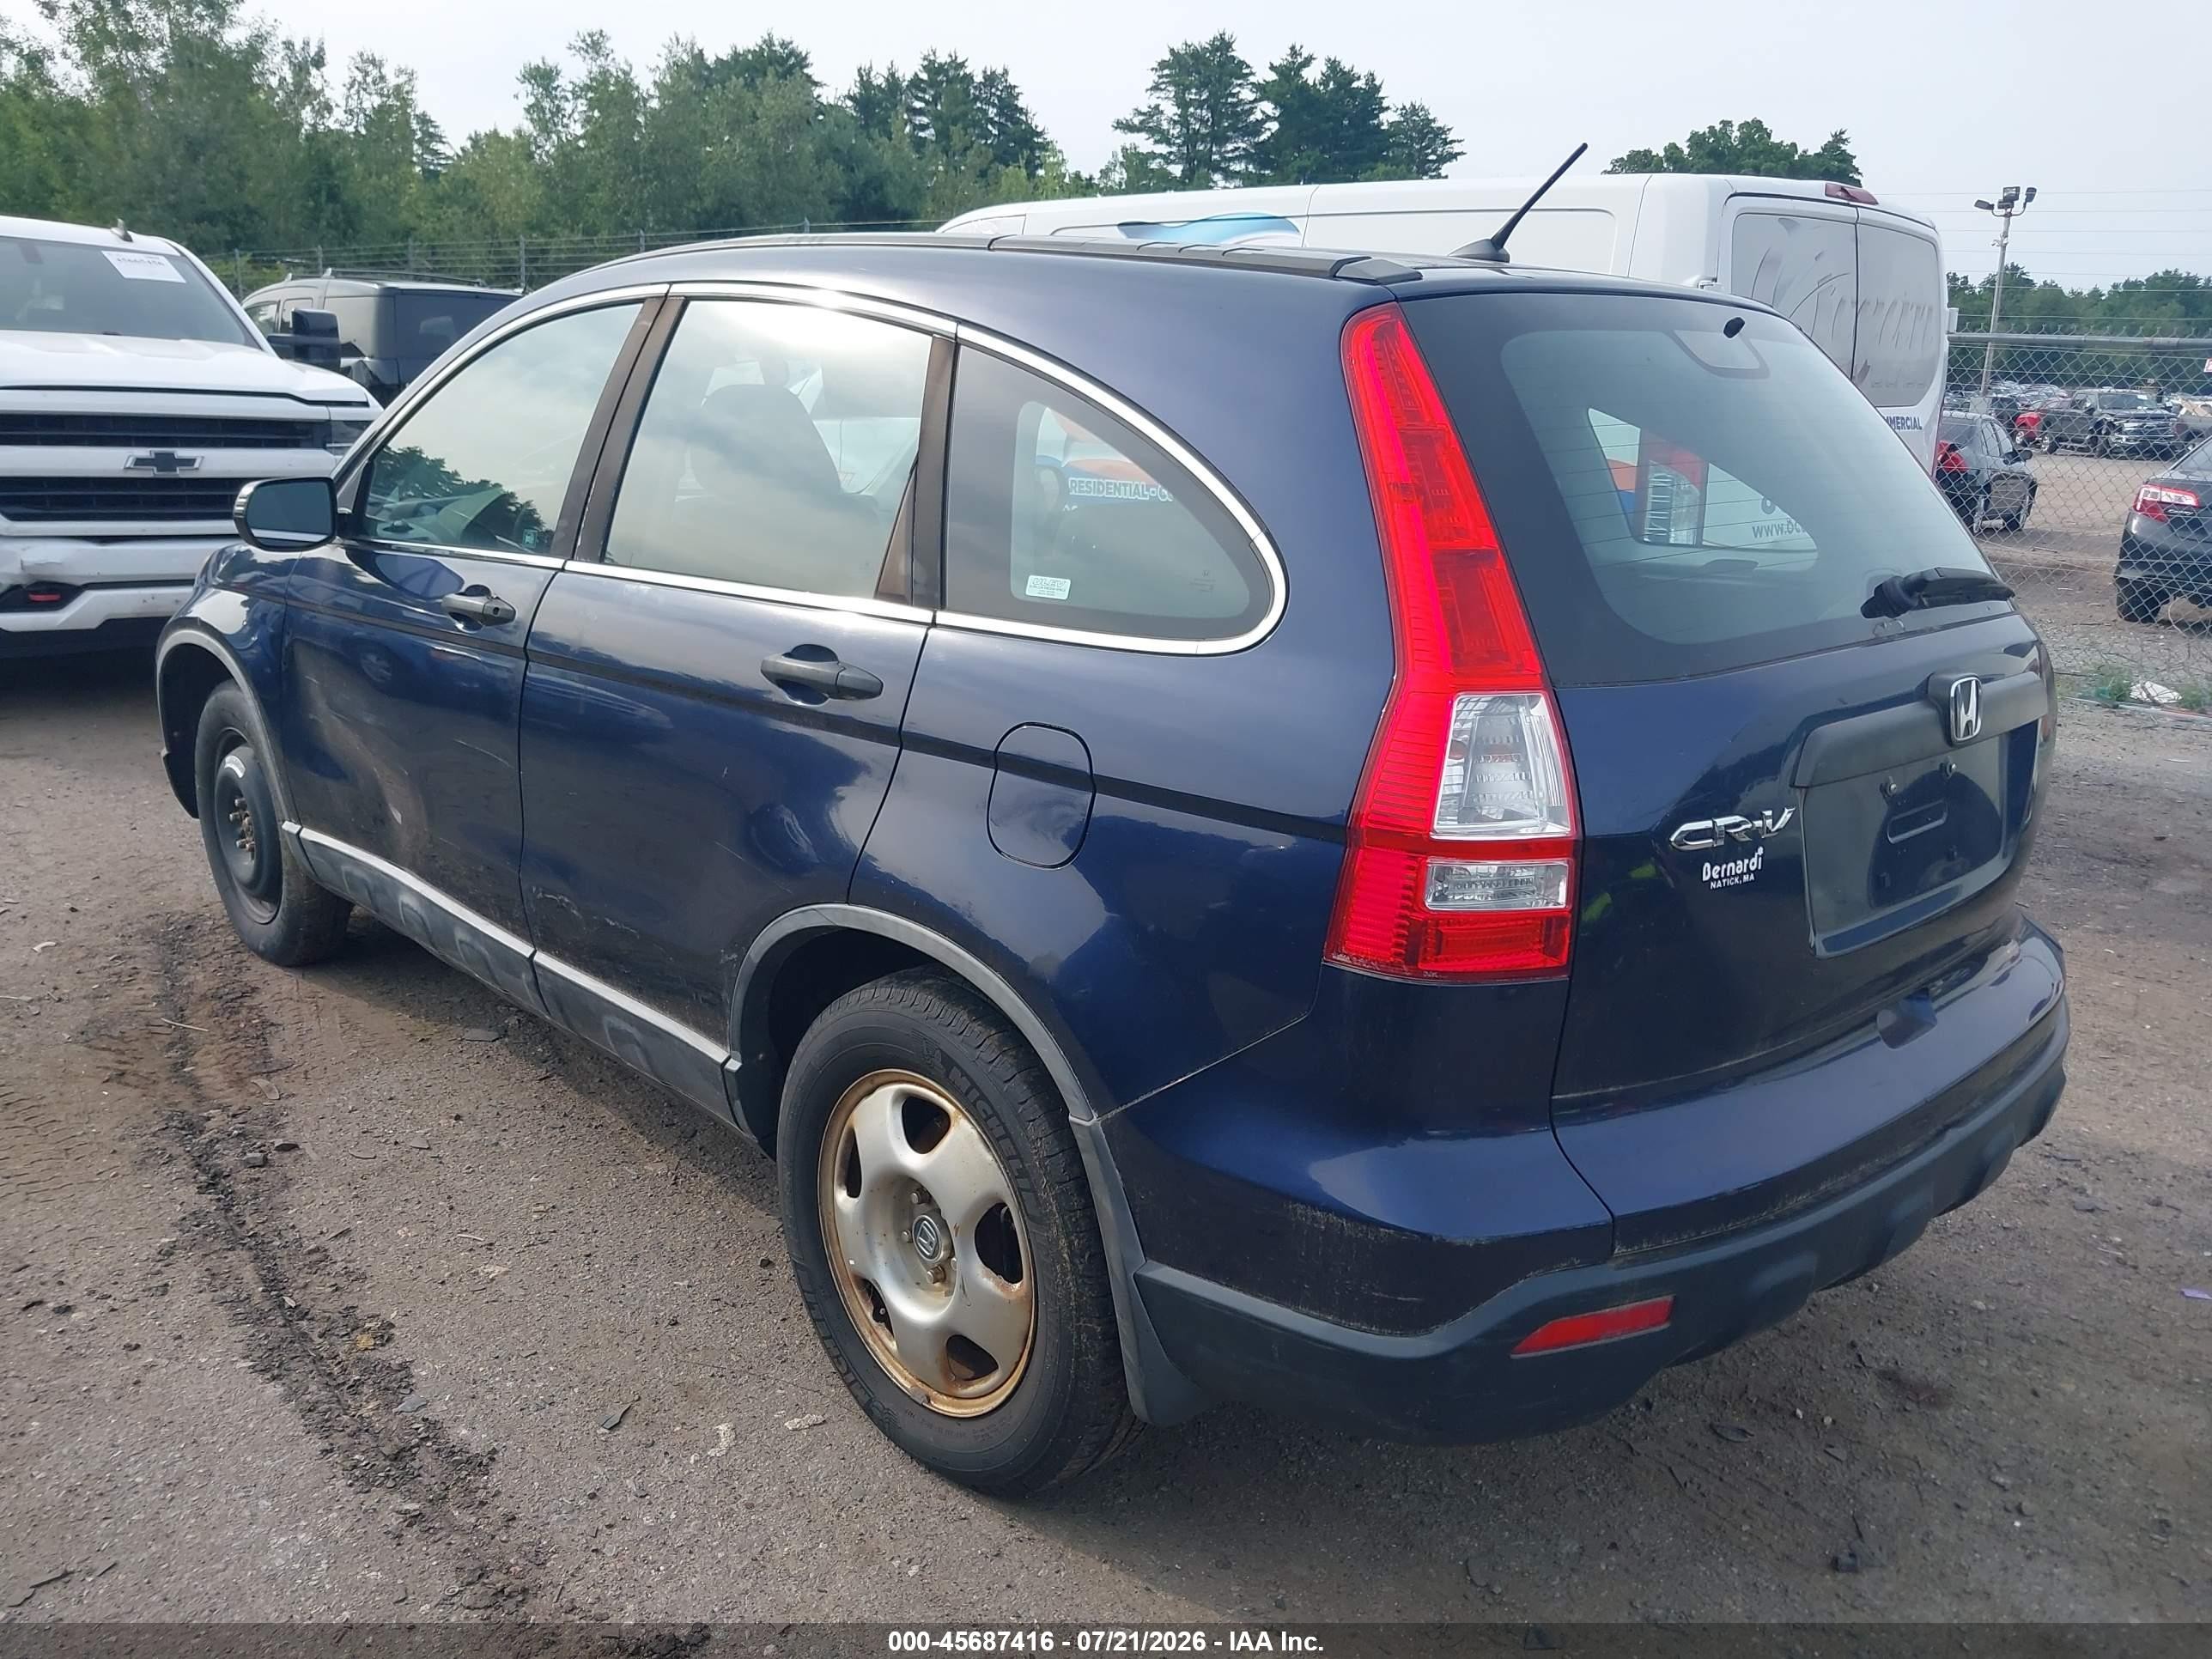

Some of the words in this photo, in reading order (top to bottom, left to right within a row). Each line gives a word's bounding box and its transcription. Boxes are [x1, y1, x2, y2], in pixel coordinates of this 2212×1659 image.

[1669, 807, 1796, 851] CR-V
[1702, 846, 1764, 883] Bernardi
[1710, 877, 1742, 890] NATICK,
[1742, 872, 1755, 885] MA
